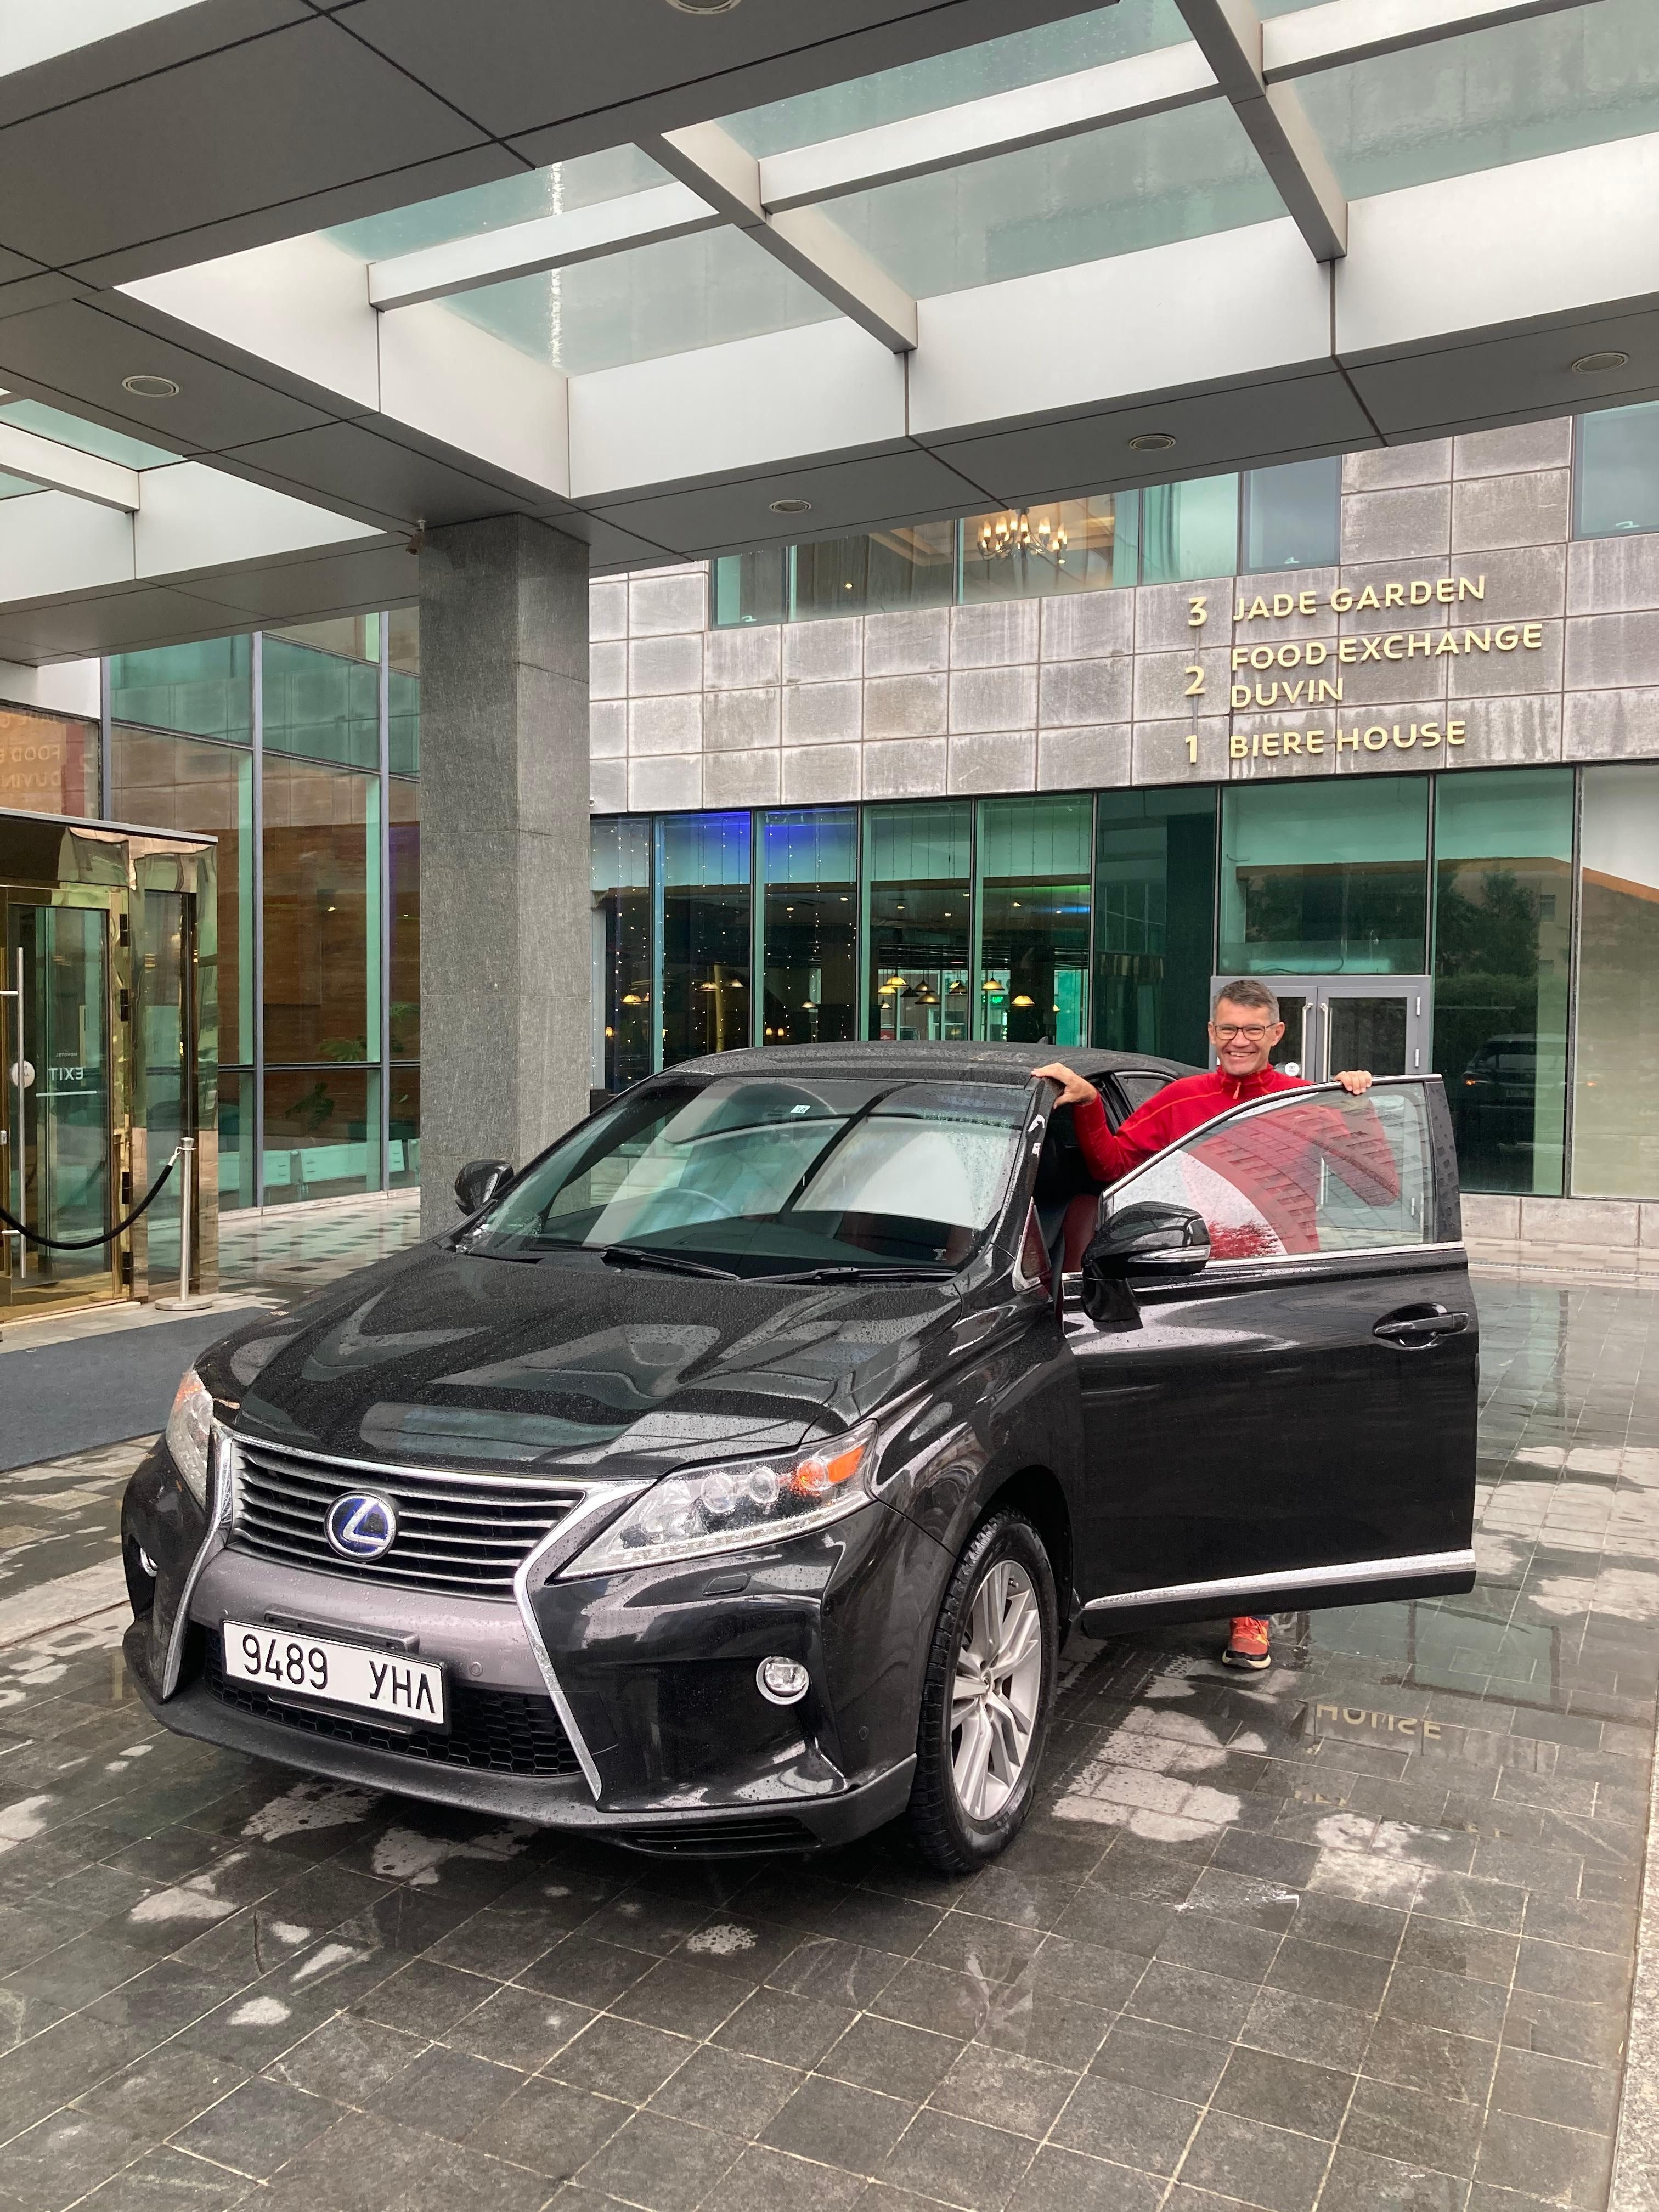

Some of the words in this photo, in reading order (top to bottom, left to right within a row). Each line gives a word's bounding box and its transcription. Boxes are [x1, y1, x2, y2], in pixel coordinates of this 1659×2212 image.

[1188, 596, 1207, 627] 3
[1233, 591, 1317, 621] JADE
[1330, 575, 1486, 612] GARDEN
[1231, 641, 1327, 672] FOOD
[1339, 623, 1542, 663] EXCHANGE
[1185, 666, 1205, 696] 2
[1231, 678, 1344, 708] DUVIN
[1185, 735, 1198, 763] 1
[1230, 730, 1324, 758] BIERE
[1338, 720, 1466, 752] HOUSE
[242, 1634, 328, 1690] 9489
